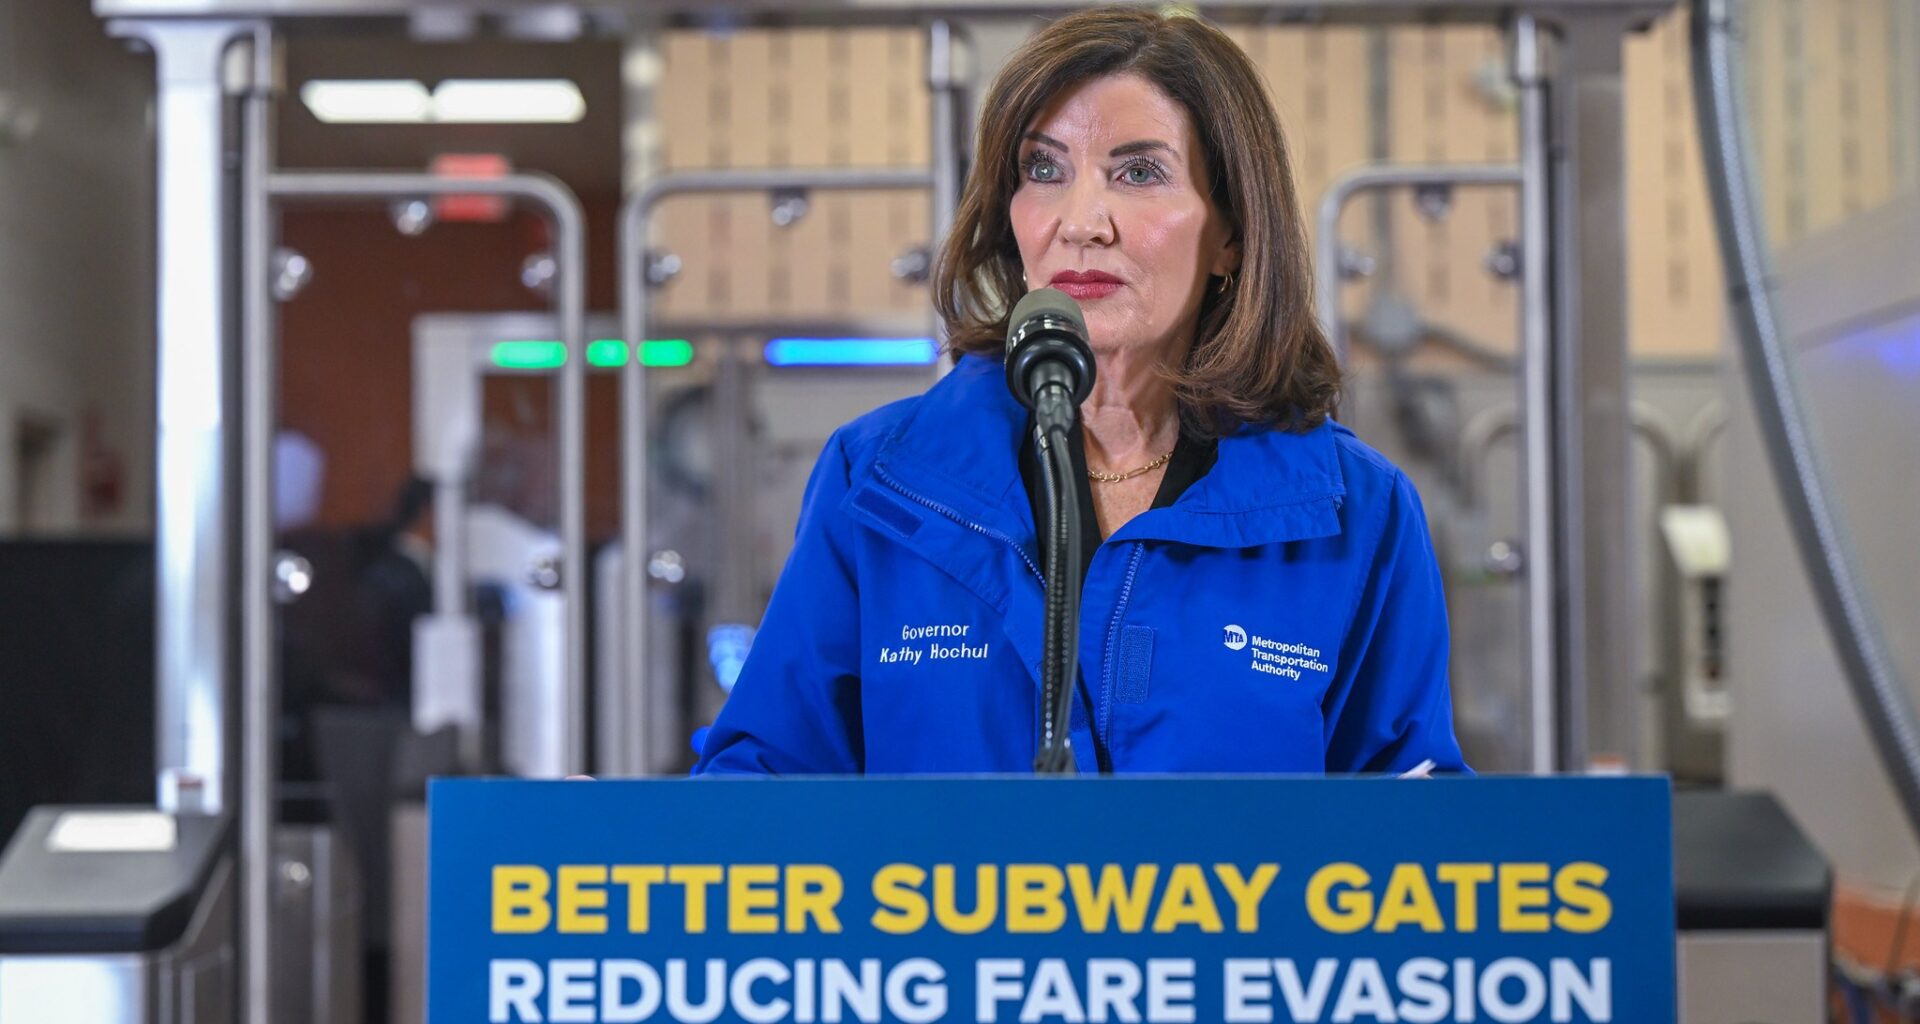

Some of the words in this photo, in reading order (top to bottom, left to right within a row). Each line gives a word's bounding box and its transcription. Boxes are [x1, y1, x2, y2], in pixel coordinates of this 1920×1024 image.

[902, 624, 970, 640] Governor
[879, 646, 922, 665] Kathy
[930, 643, 989, 659] Hochul
[1251, 635, 1320, 658] Metropolitan
[1251, 647, 1328, 673] Transportation
[1251, 660, 1301, 681] Authority
[491, 864, 843, 933] BETTER
[870, 862, 1280, 934] SUBWAY
[1305, 862, 1612, 934] GATES
[489, 957, 948, 1023] REDUCING
[976, 957, 1196, 1023] FARE
[1223, 957, 1611, 1023] EVASION
